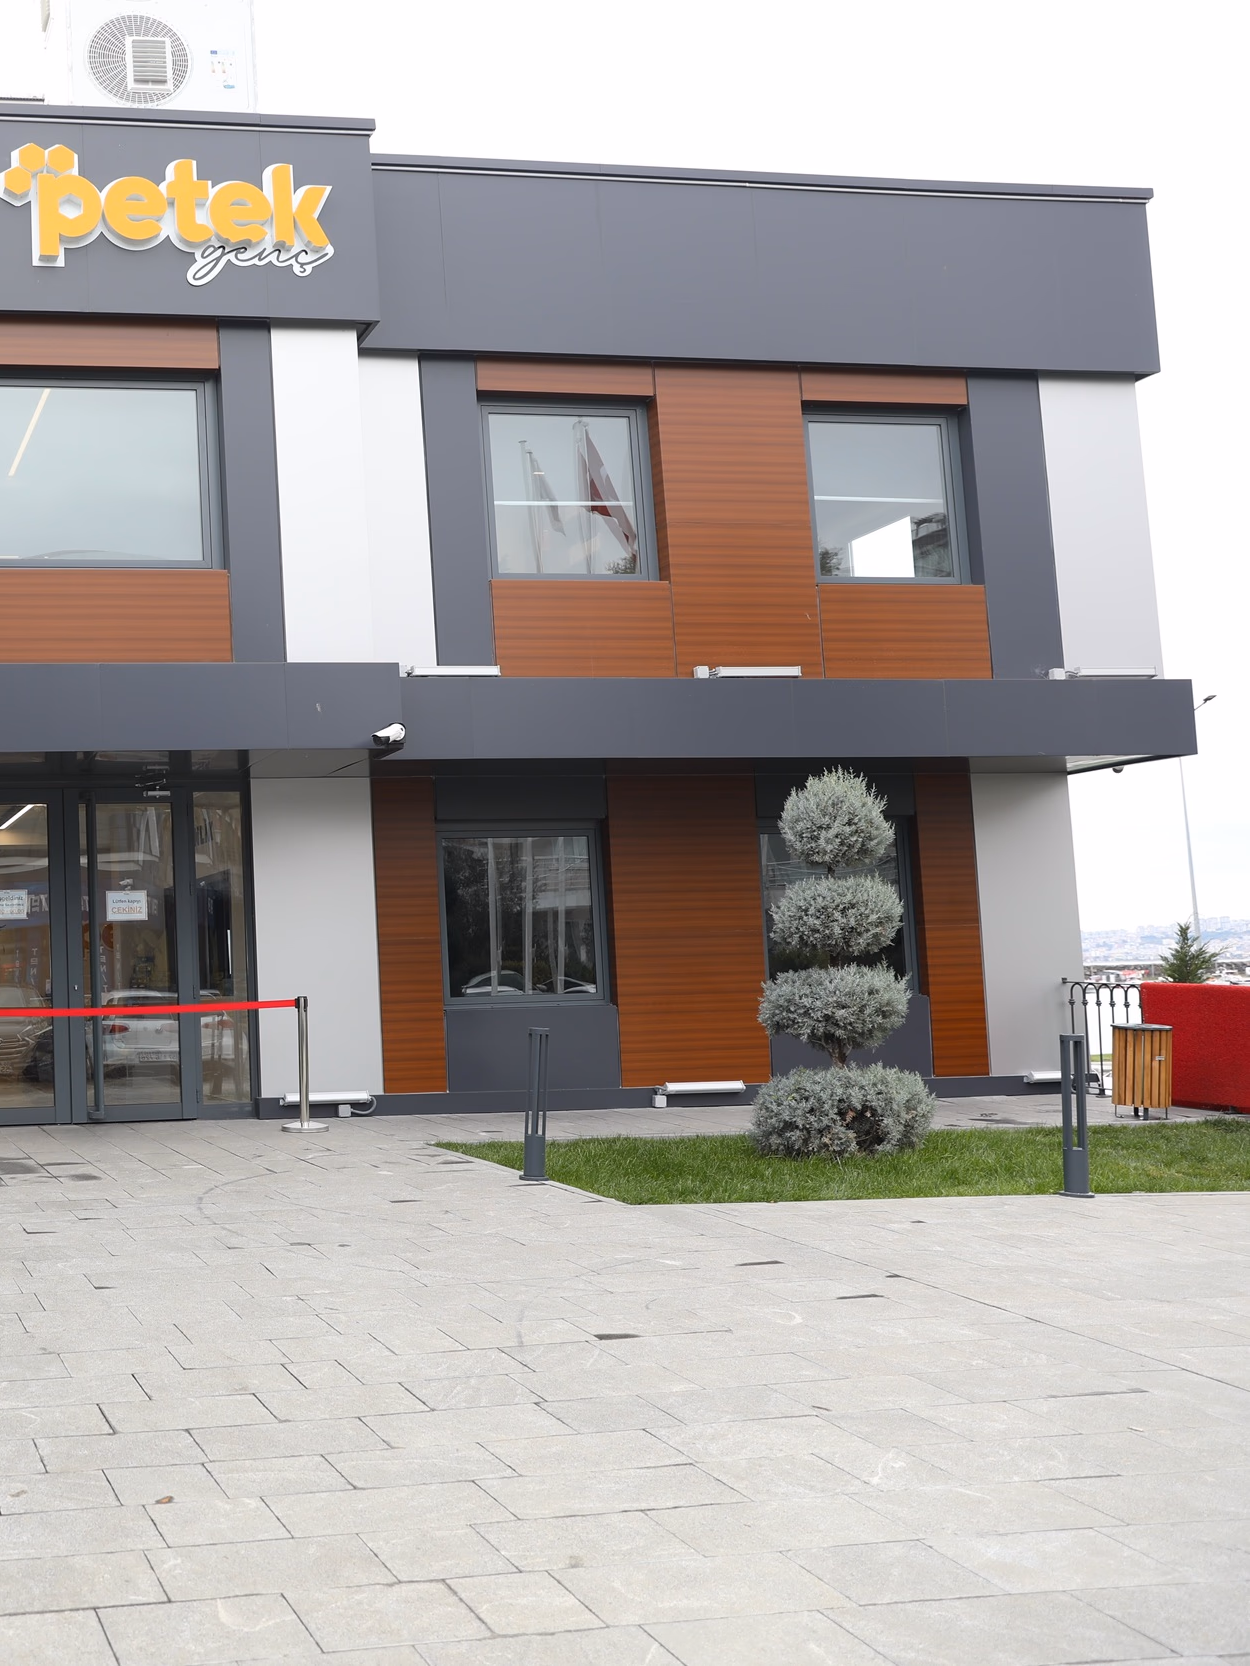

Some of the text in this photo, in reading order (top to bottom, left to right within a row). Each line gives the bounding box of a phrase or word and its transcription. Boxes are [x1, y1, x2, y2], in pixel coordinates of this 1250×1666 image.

[35, 158, 330, 263] petek
[191, 244, 329, 281] genç
[111, 905, 142, 914] ÇEKİNİZ
